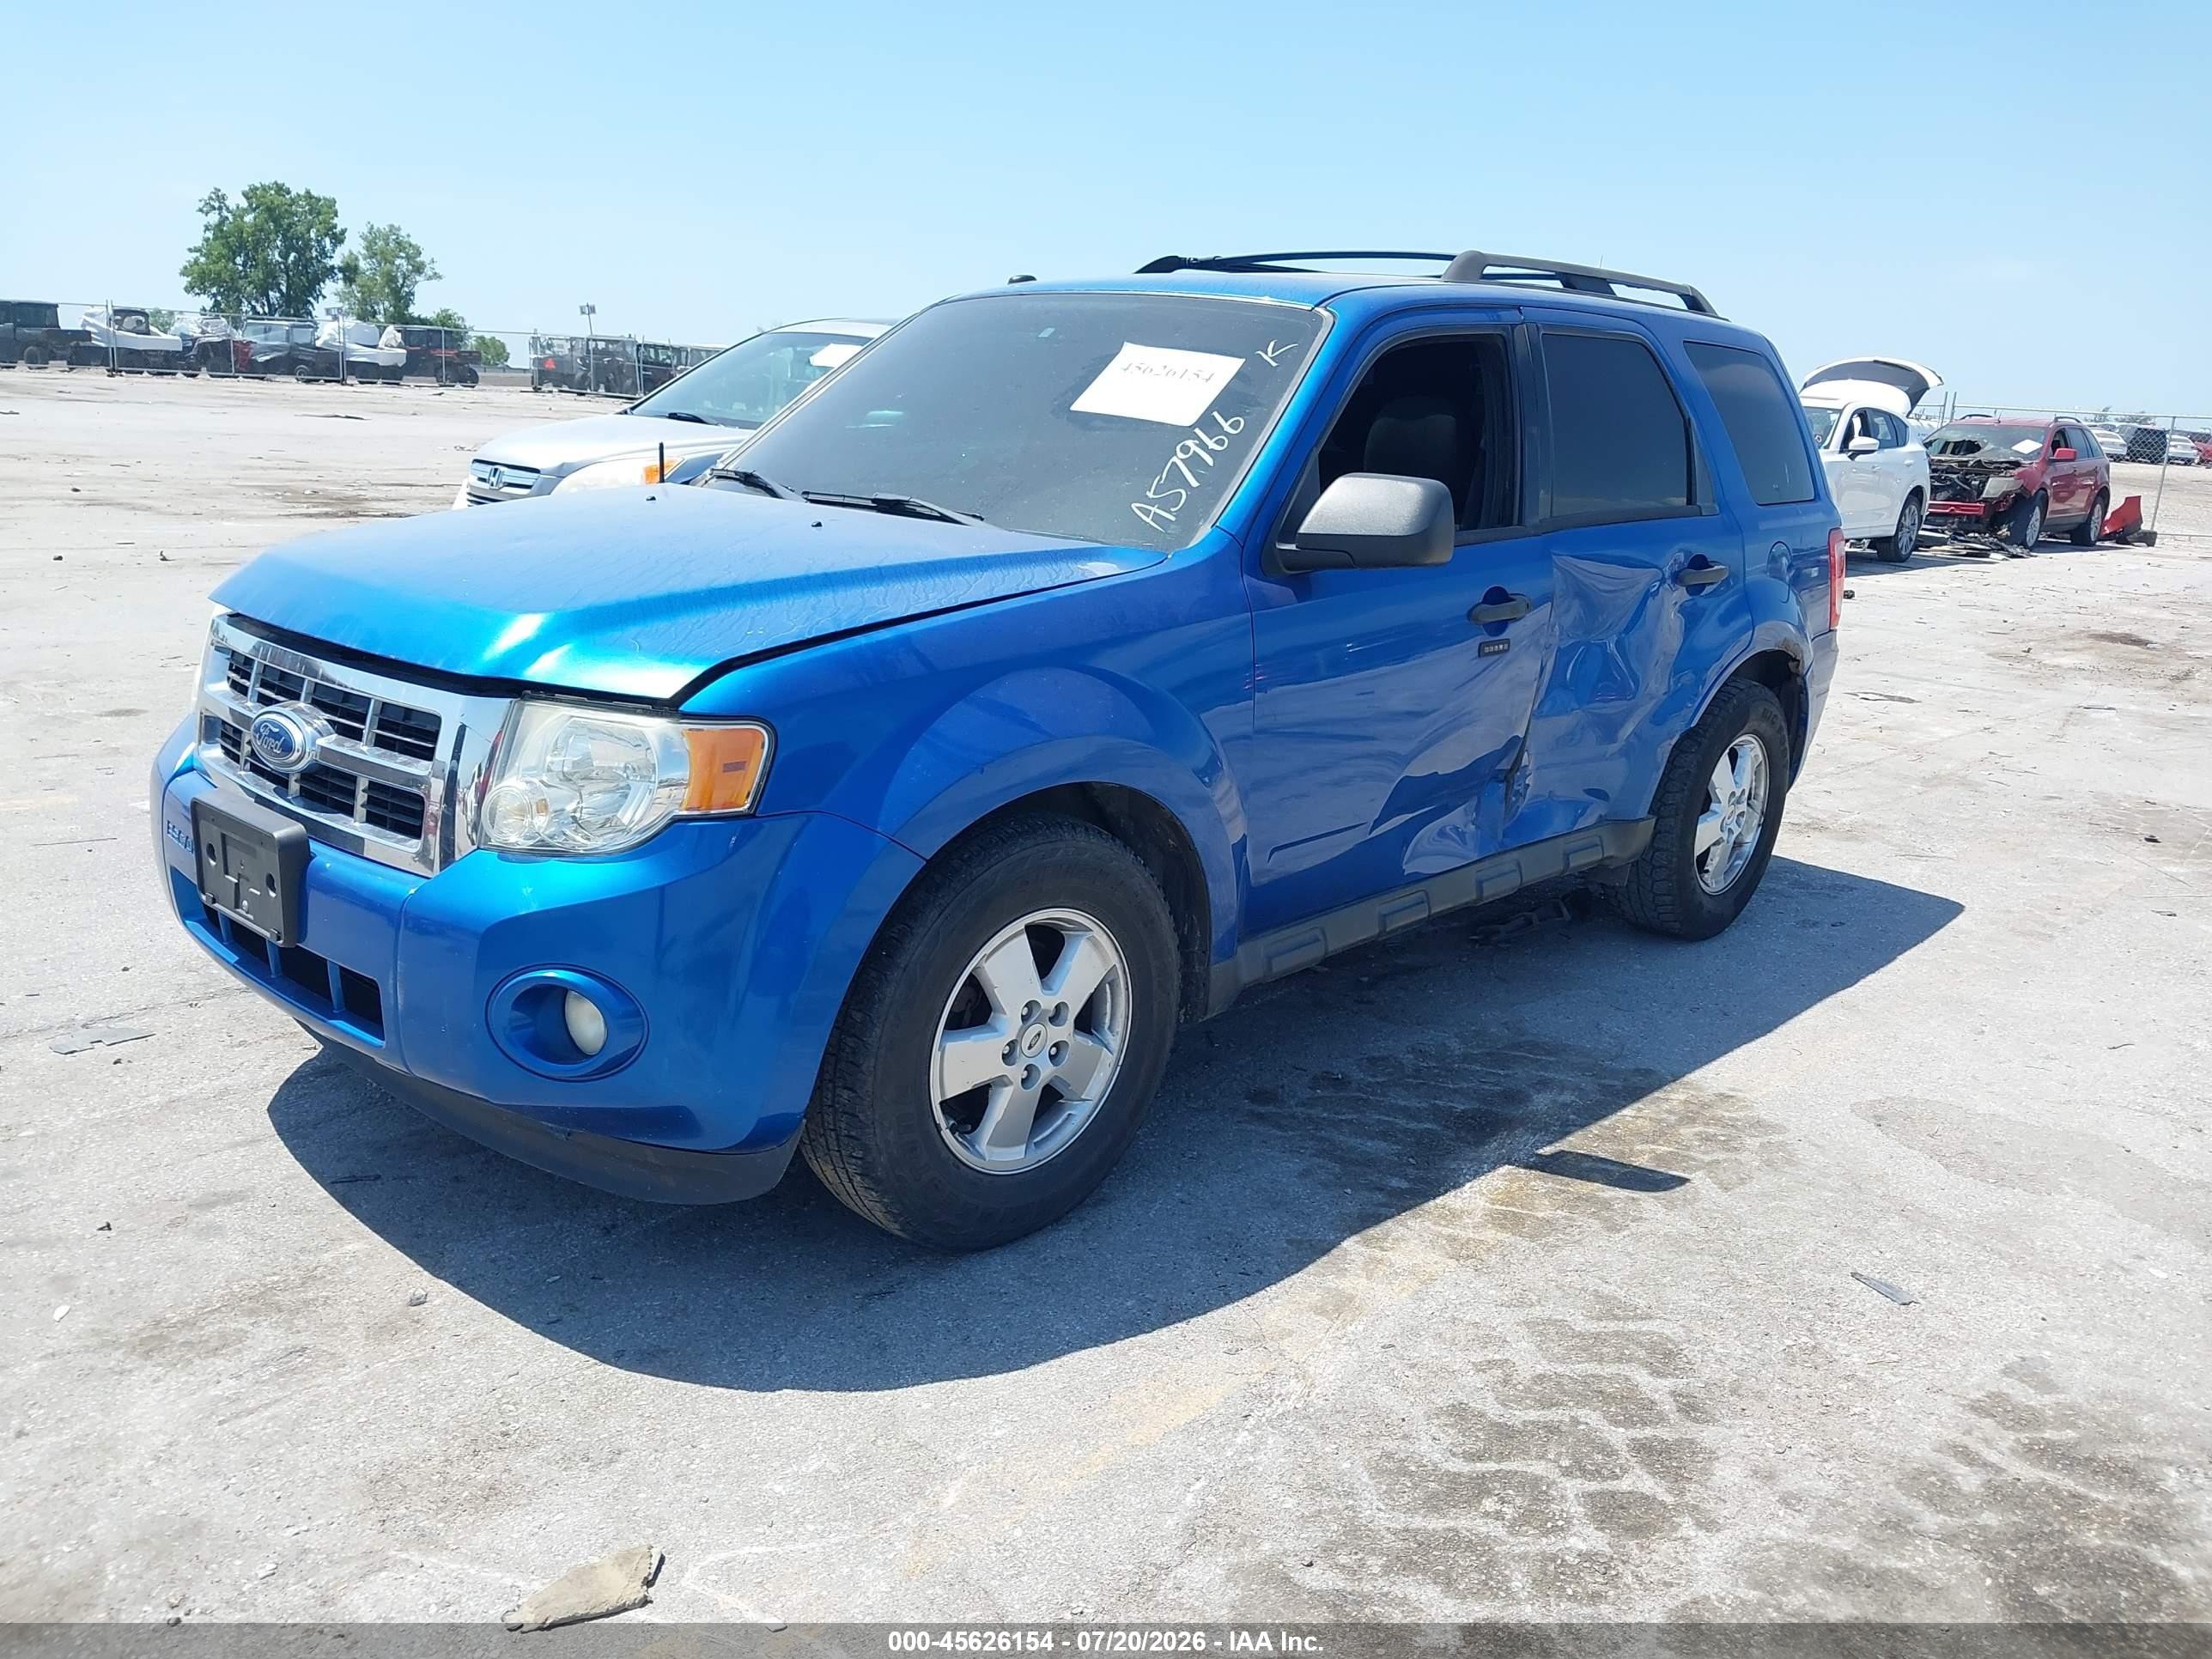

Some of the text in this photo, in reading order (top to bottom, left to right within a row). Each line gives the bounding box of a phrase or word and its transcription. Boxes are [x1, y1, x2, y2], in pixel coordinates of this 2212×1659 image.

[1255, 339, 1298, 367] K
[255, 722, 285, 754] Ford
[167, 819, 194, 854] ESCA
